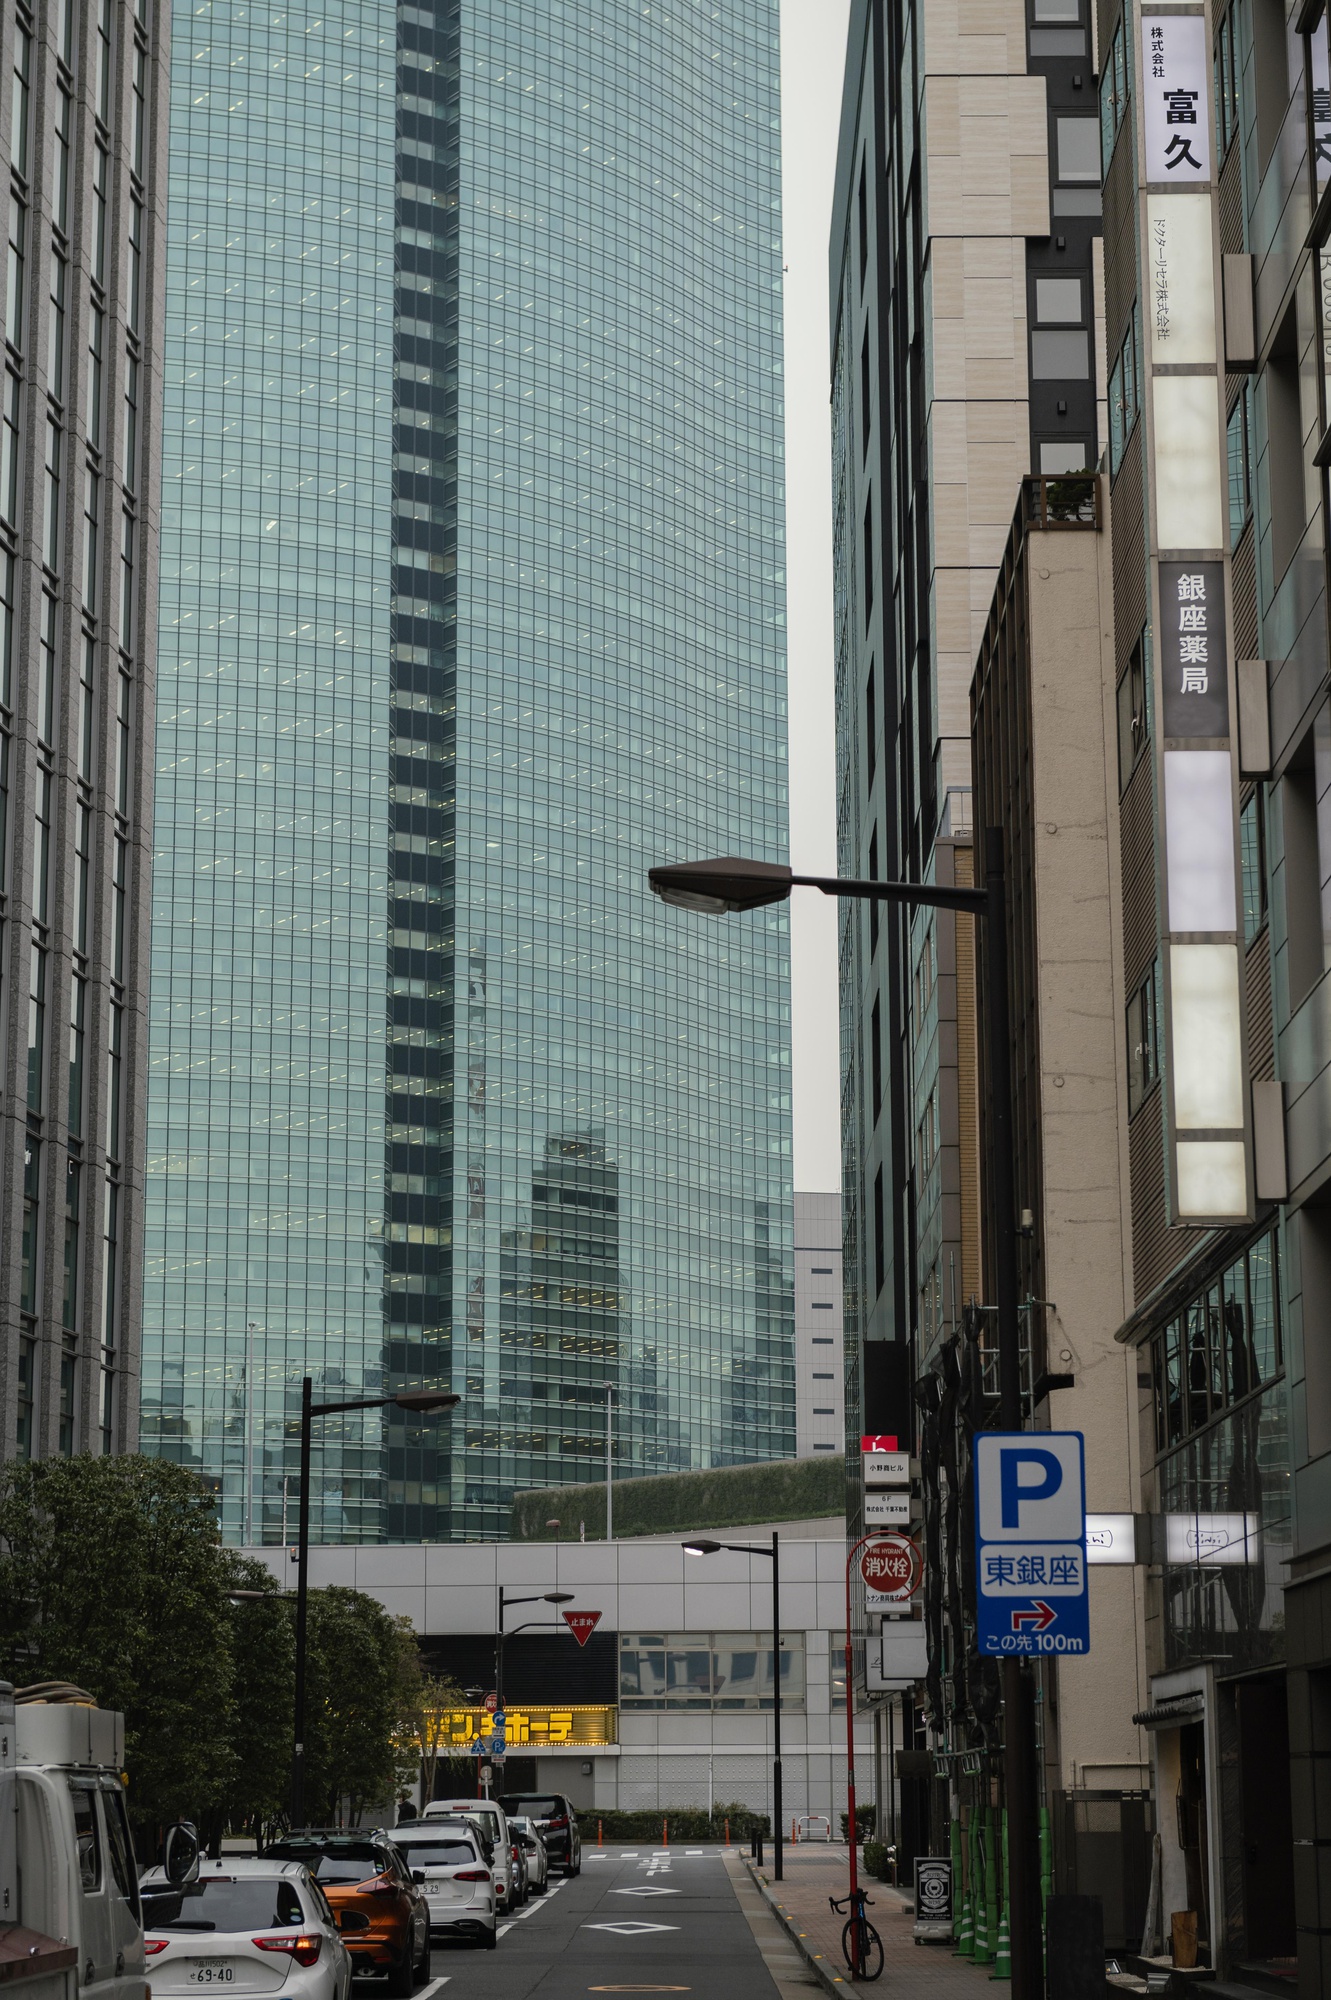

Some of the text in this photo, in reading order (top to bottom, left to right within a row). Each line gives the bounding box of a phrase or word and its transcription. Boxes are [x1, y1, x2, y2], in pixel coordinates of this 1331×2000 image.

[1150, 26, 1166, 79] 株式会社
[1163, 88, 1203, 171] 富久
[1153, 218, 1170, 341] ドクターリセラ株式会社
[1177, 573, 1209, 694] 銀座薬局
[1000, 1448, 1063, 1529] P
[865, 1556, 909, 1578] 消火栓
[869, 1547, 904, 1555] FIRE HYDRANT
[984, 1554, 1080, 1587] 東銀座
[571, 1617, 594, 1627] 止まれ
[985, 1633, 1083, 1651] この先 100m
[197, 1968, 233, 1982] 69-40
